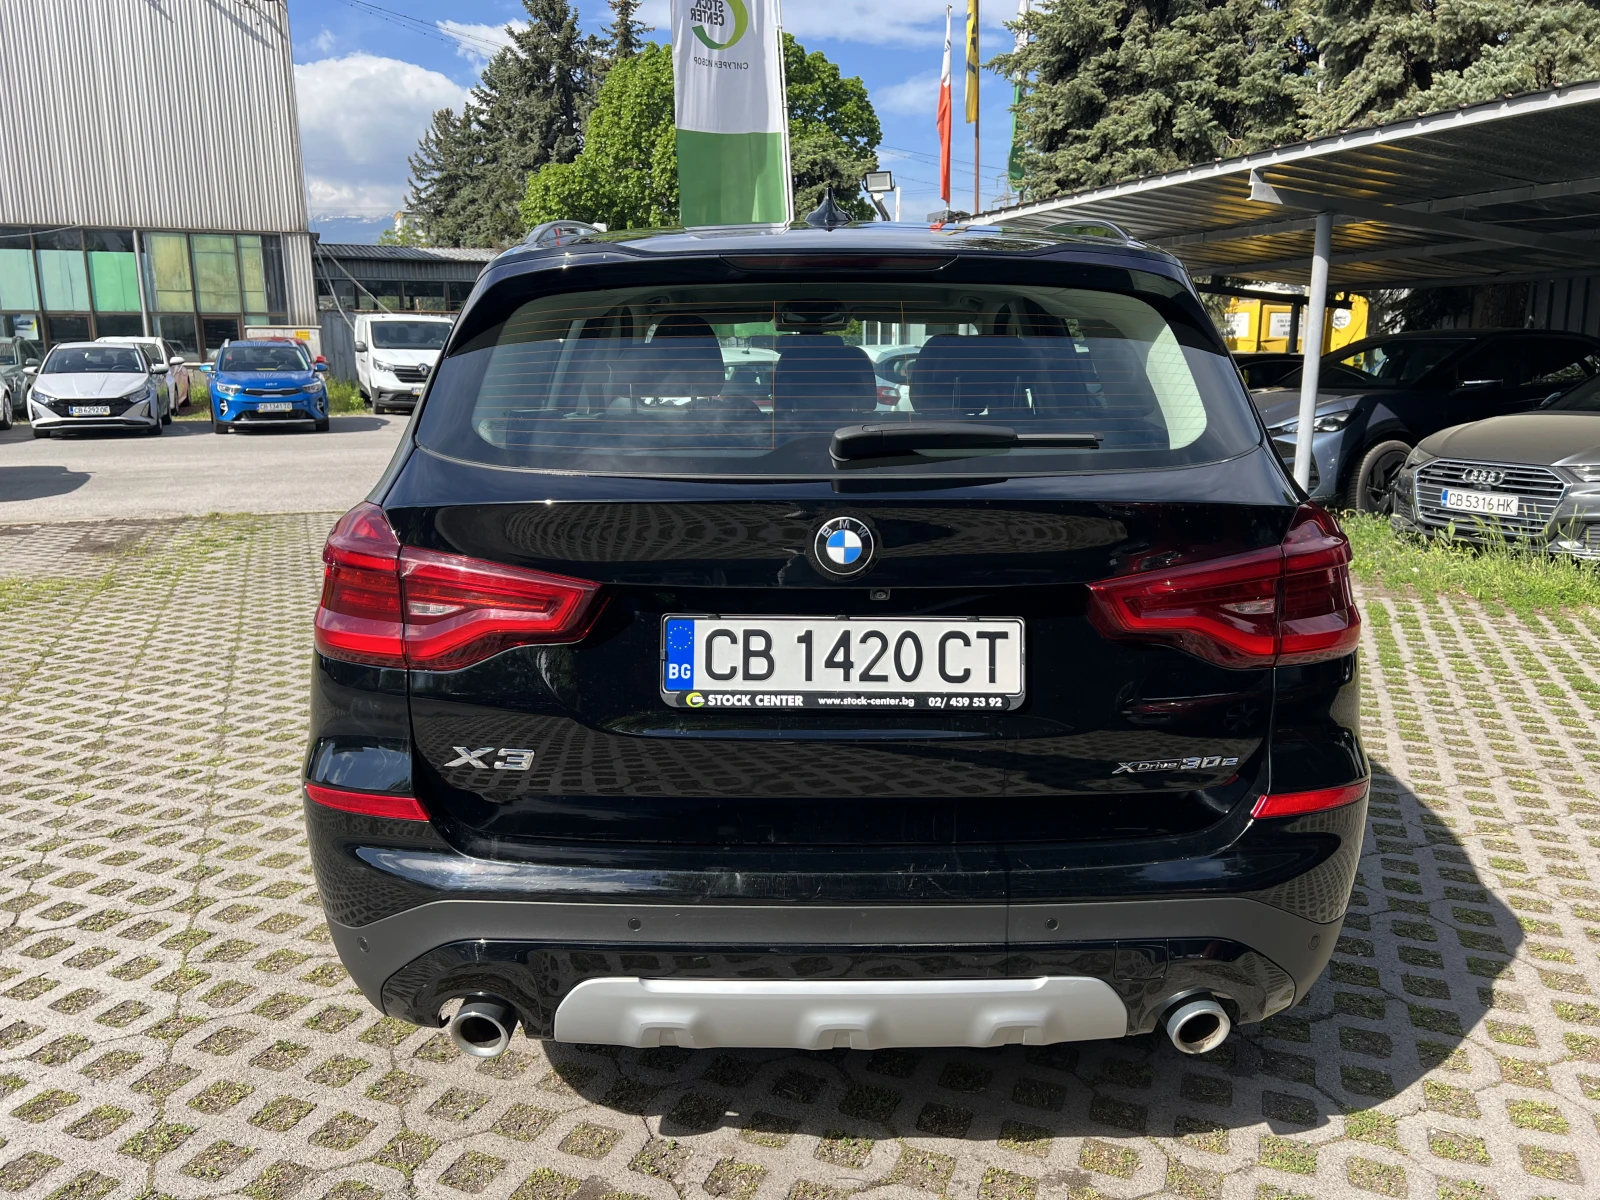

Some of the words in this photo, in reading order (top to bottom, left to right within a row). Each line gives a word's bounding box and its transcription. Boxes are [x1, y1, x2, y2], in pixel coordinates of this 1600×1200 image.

[1449, 492, 1463, 507] CB
[1465, 495, 1494, 510] 5316
[1496, 498, 1514, 512] HK
[820, 519, 869, 539] BMW
[704, 628, 775, 682] CB
[796, 629, 923, 683] 1420
[938, 630, 1009, 684] CT
[668, 663, 691, 679] BG
[707, 694, 751, 706] STOCK
[755, 695, 804, 706] CENTER
[818, 696, 915, 707] www.stock-center.bg
[928, 697, 947, 708] 02/
[949, 697, 969, 707] 439
[972, 698, 986, 707] 53
[988, 697, 1002, 707] 92
[443, 746, 535, 771] X3
